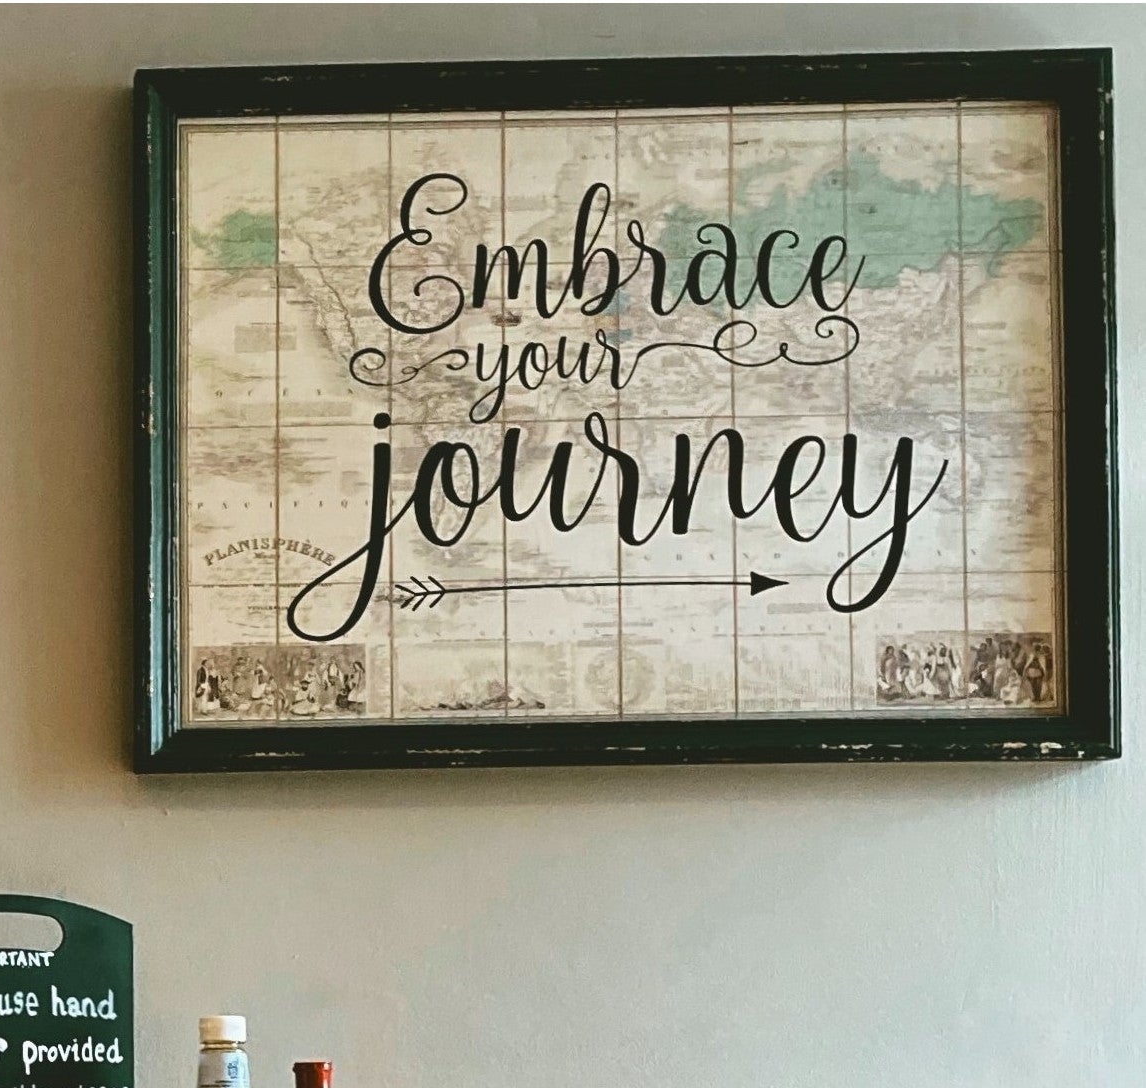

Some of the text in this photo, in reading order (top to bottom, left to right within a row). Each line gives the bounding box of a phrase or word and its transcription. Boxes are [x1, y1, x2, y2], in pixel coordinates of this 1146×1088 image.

[368, 172, 865, 335] Embrace
[285, 411, 949, 643] journey
[203, 537, 336, 567] PLANISPHÈRE
[51, 985, 118, 1021] hand
[22, 1037, 124, 1075] provided
